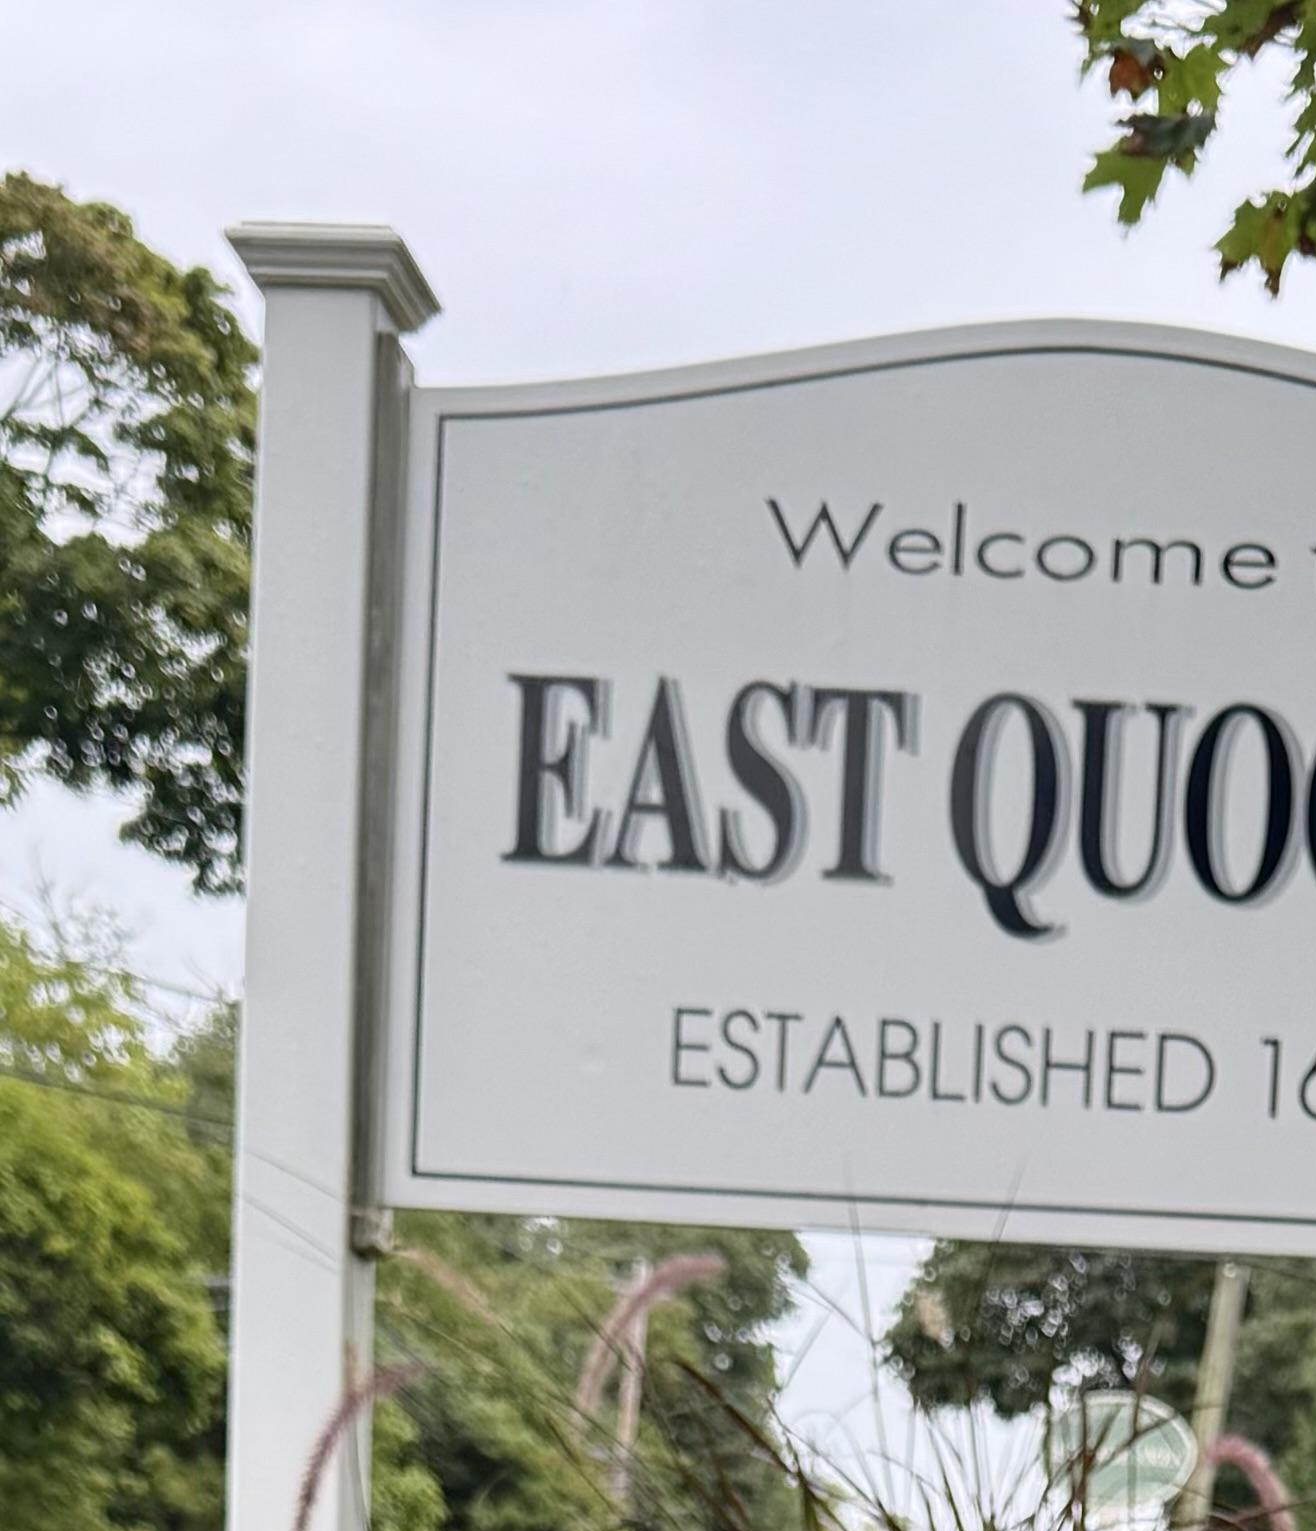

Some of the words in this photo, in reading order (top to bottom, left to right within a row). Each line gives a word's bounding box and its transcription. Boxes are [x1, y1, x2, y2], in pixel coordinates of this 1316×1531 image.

[765, 497, 1279, 591] Welcome
[499, 672, 920, 887] EAST
[671, 1006, 1217, 1113] ESTABLISHED
